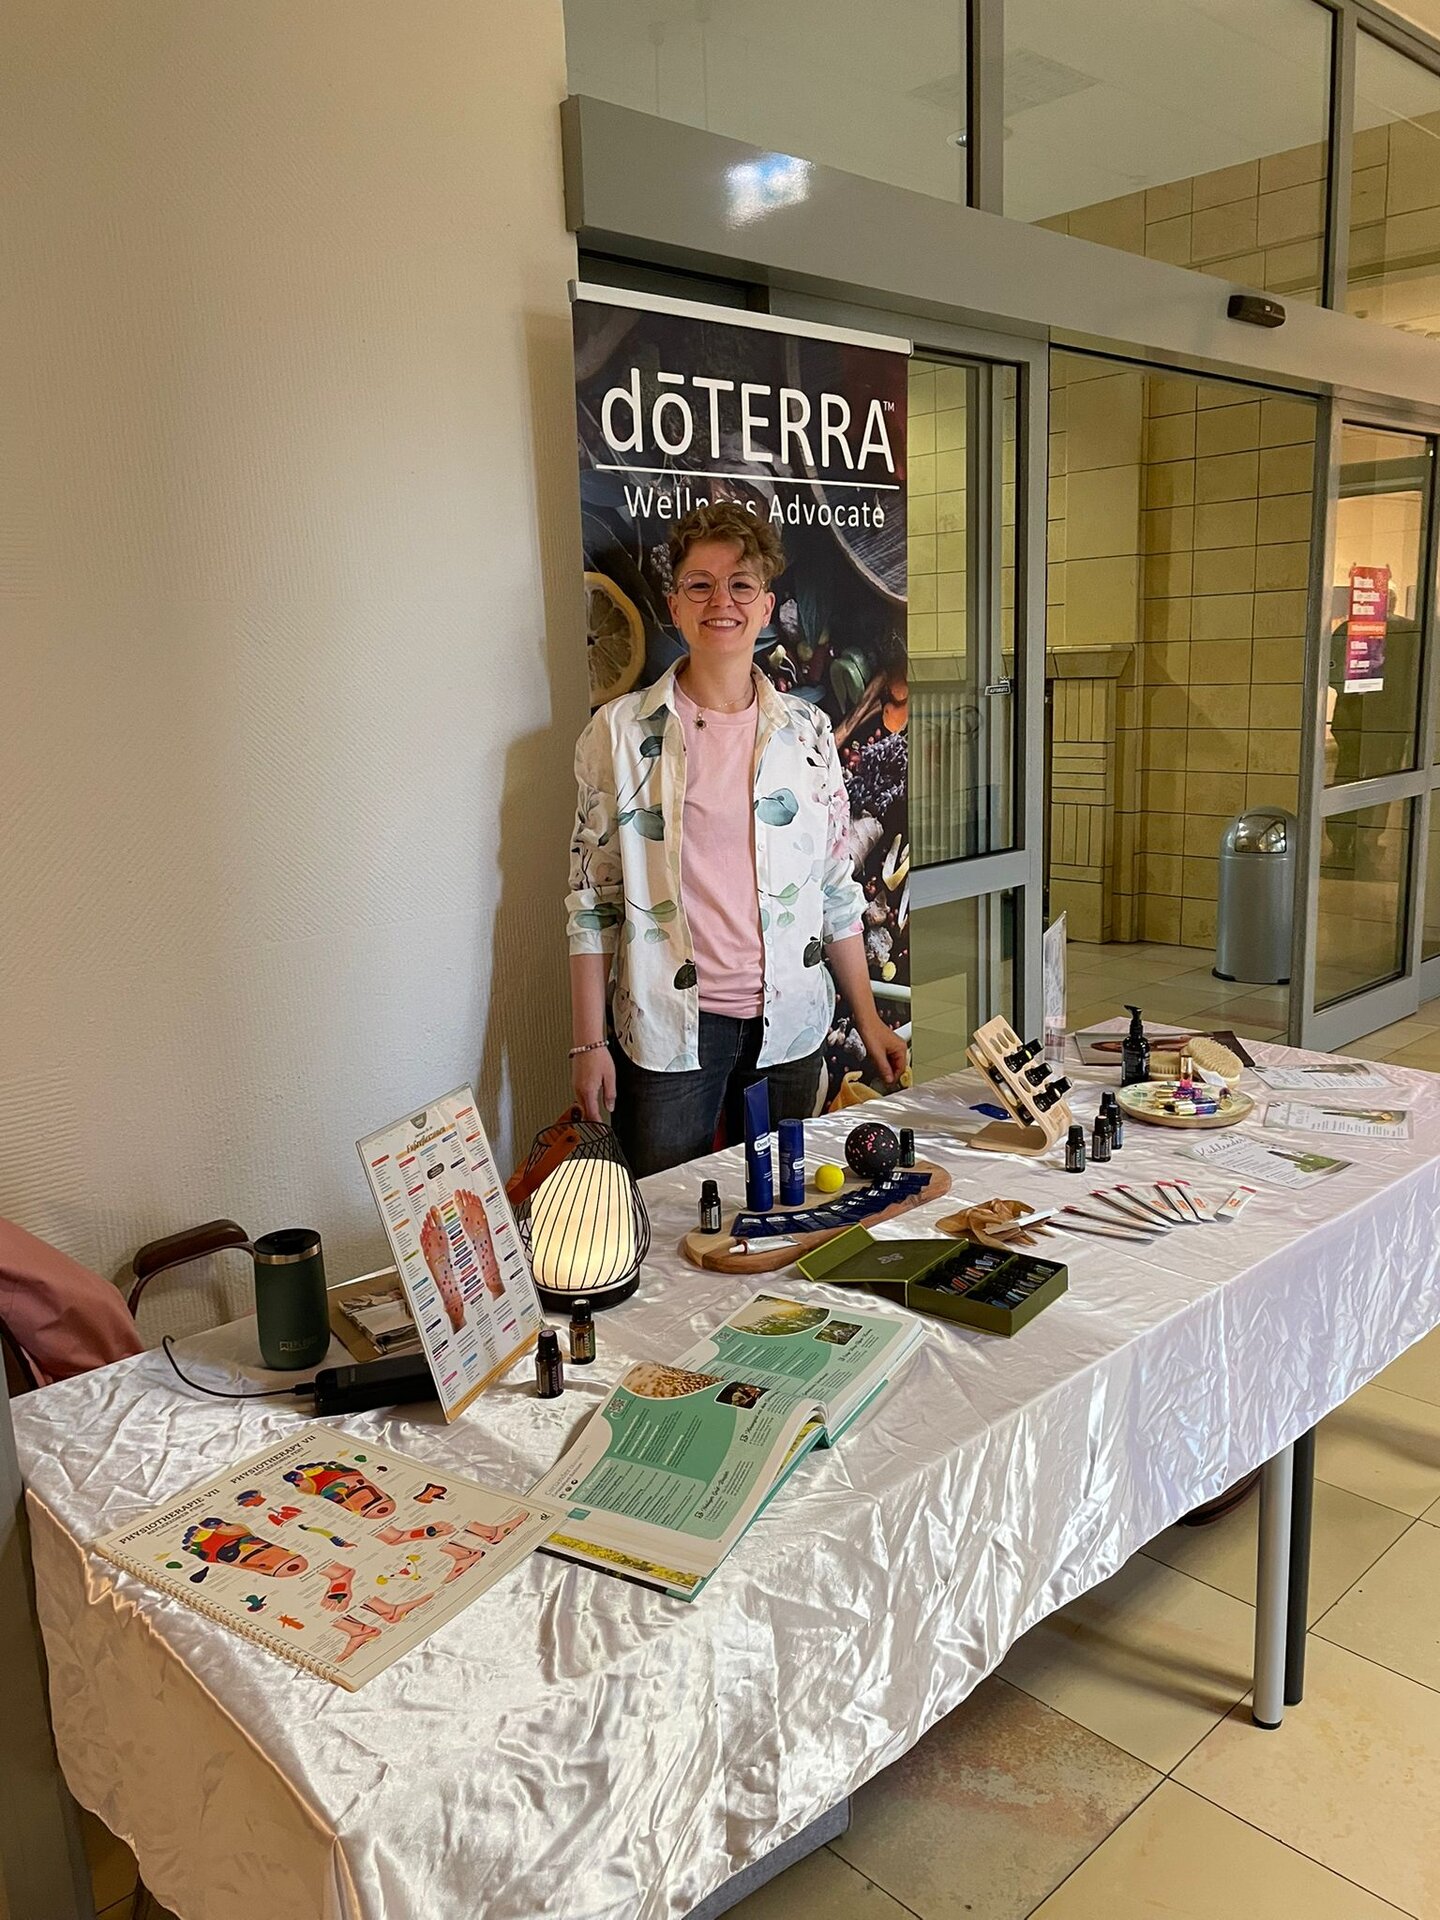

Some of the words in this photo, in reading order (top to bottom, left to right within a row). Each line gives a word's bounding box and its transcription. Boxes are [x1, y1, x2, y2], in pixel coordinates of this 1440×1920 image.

[623, 485, 757, 520] Wellns
[768, 494, 885, 529] Advocate
[230, 1443, 302, 1484] PHYSIOTHERAPY
[301, 1434, 316, 1445] VII
[119, 1497, 205, 1544] PHYSIOTHERAPIE
[204, 1488, 220, 1499] VII
